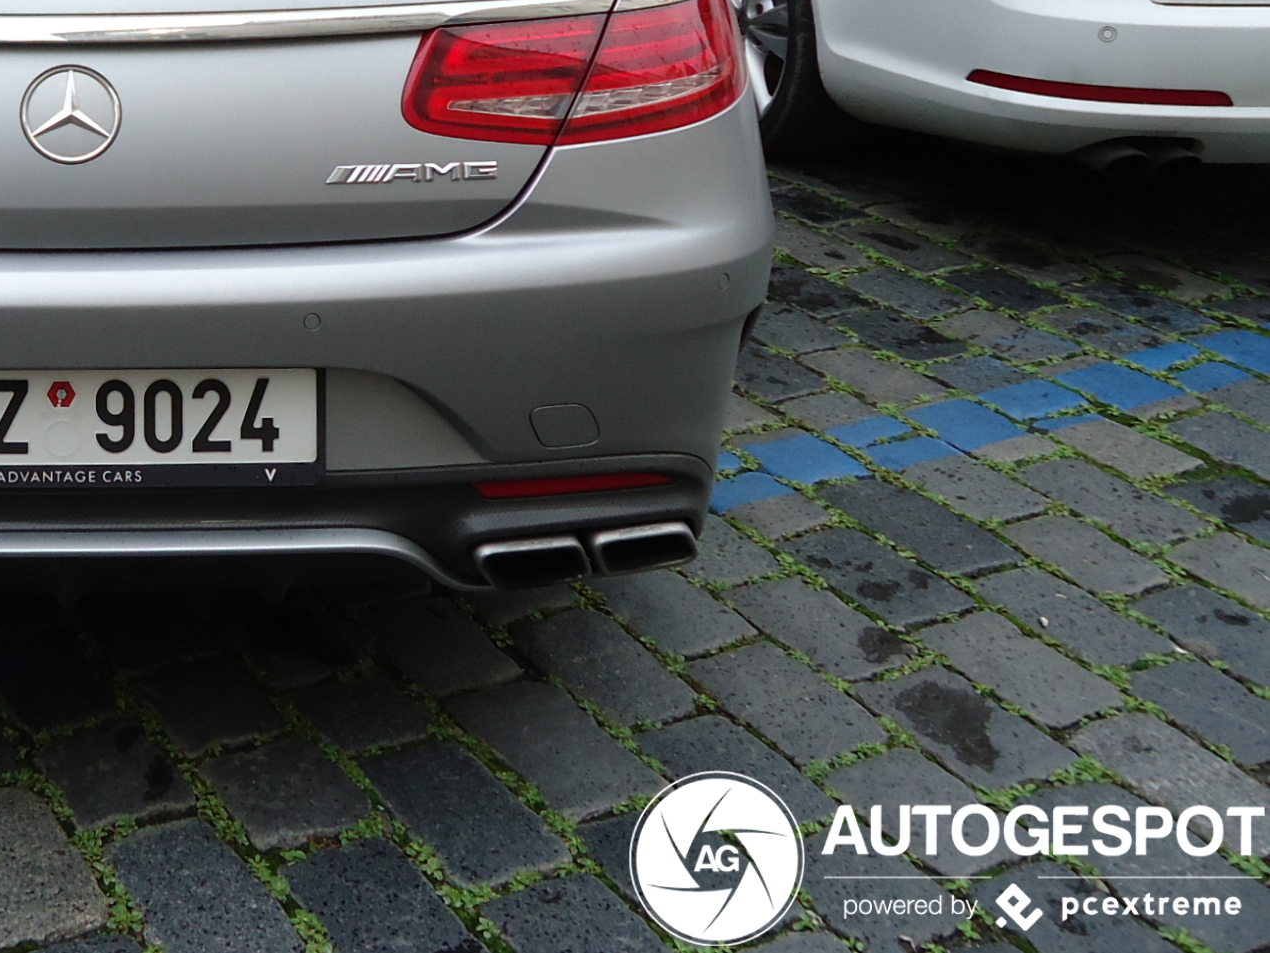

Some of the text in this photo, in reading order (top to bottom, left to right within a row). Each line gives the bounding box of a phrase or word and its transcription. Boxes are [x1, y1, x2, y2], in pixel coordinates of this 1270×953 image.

[383, 160, 498, 183] AMG
[96, 378, 279, 454] 9024
[102, 470, 143, 483] CARS
